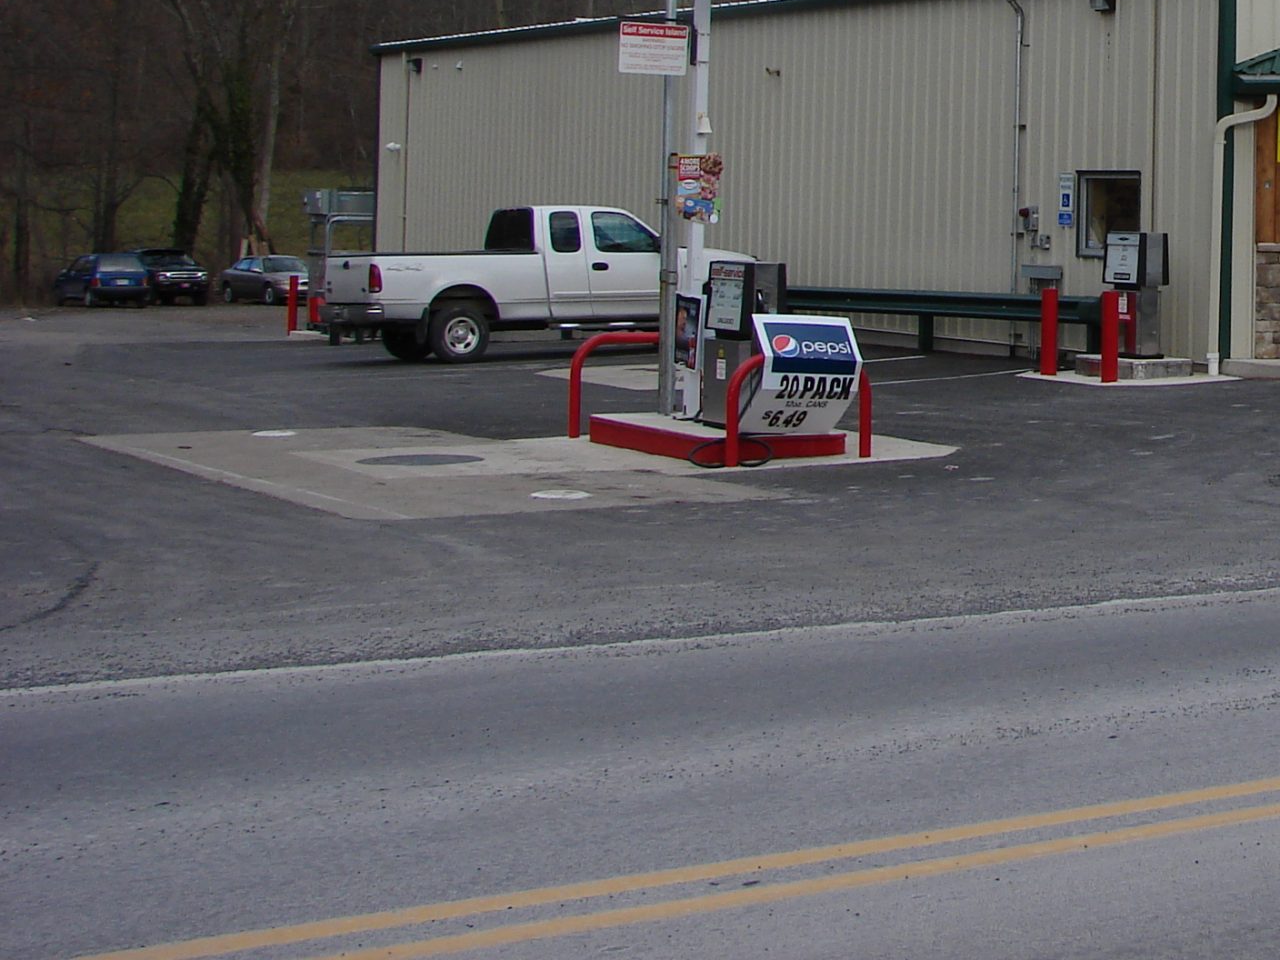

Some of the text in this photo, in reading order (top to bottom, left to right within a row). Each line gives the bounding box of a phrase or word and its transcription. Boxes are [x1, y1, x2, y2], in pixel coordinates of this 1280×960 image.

[623, 25, 687, 36] Self Service Island
[801, 340, 852, 356] pepsi
[775, 374, 855, 401] 20 PACK
[762, 410, 808, 428] $6.49
